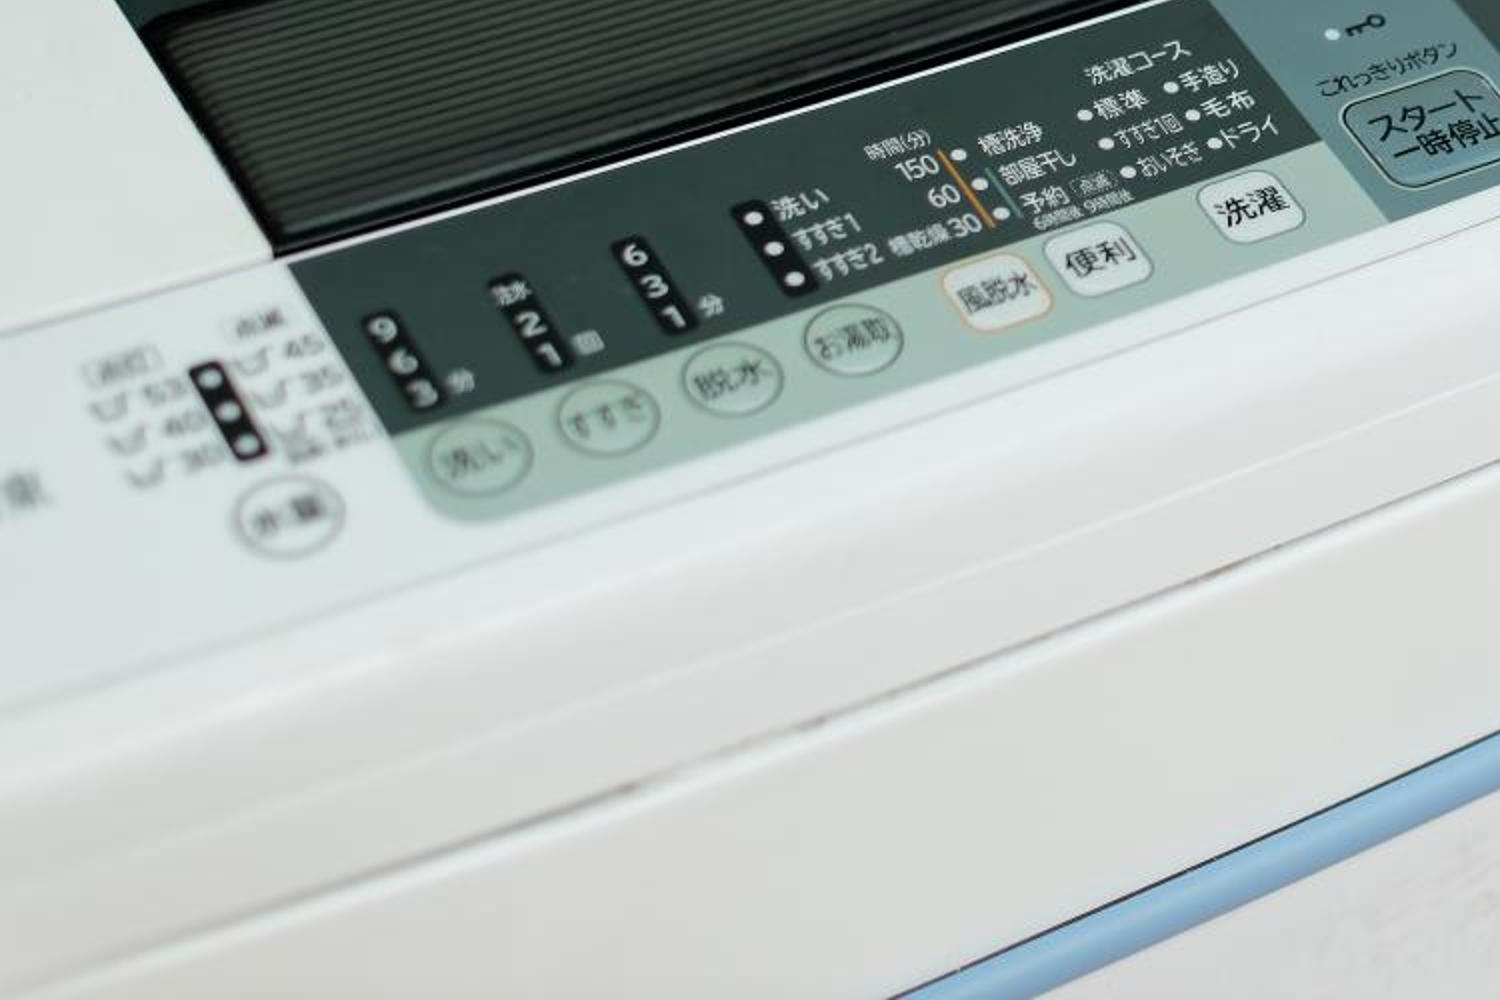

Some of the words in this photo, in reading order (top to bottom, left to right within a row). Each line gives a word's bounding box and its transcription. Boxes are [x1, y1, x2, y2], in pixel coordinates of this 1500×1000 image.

[1083, 39, 1193, 85] 洗濯コース
[1315, 41, 1458, 98] これっきりボタン
[1093, 88, 1149, 120] 標準
[1178, 58, 1240, 92] 手造り
[1113, 112, 1185, 149] すすぎ1回
[1201, 89, 1256, 118] 毛布
[1219, 113, 1280, 149] ドライ
[1367, 88, 1486, 141] スタート
[977, 121, 1043, 156] 槽洗浄
[894, 153, 941, 182] 150
[998, 149, 1077, 186] 部屋干し
[771, 187, 831, 222] 洗い
[927, 183, 962, 209] 60
[1020, 185, 1071, 215] 予約
[1213, 185, 1293, 229] 洗濯
[790, 212, 862, 251] すすぎ1
[947, 212, 983, 239] 30
[621, 242, 649, 267] 6
[813, 242, 885, 281] すすぎ2
[1065, 235, 1138, 279] 便利
[640, 274, 670, 299] 3
[955, 271, 1038, 315] 風脱水
[368, 315, 399, 344] 9
[515, 310, 548, 338] 2
[661, 304, 687, 329] 1
[693, 359, 773, 401] 脱水
